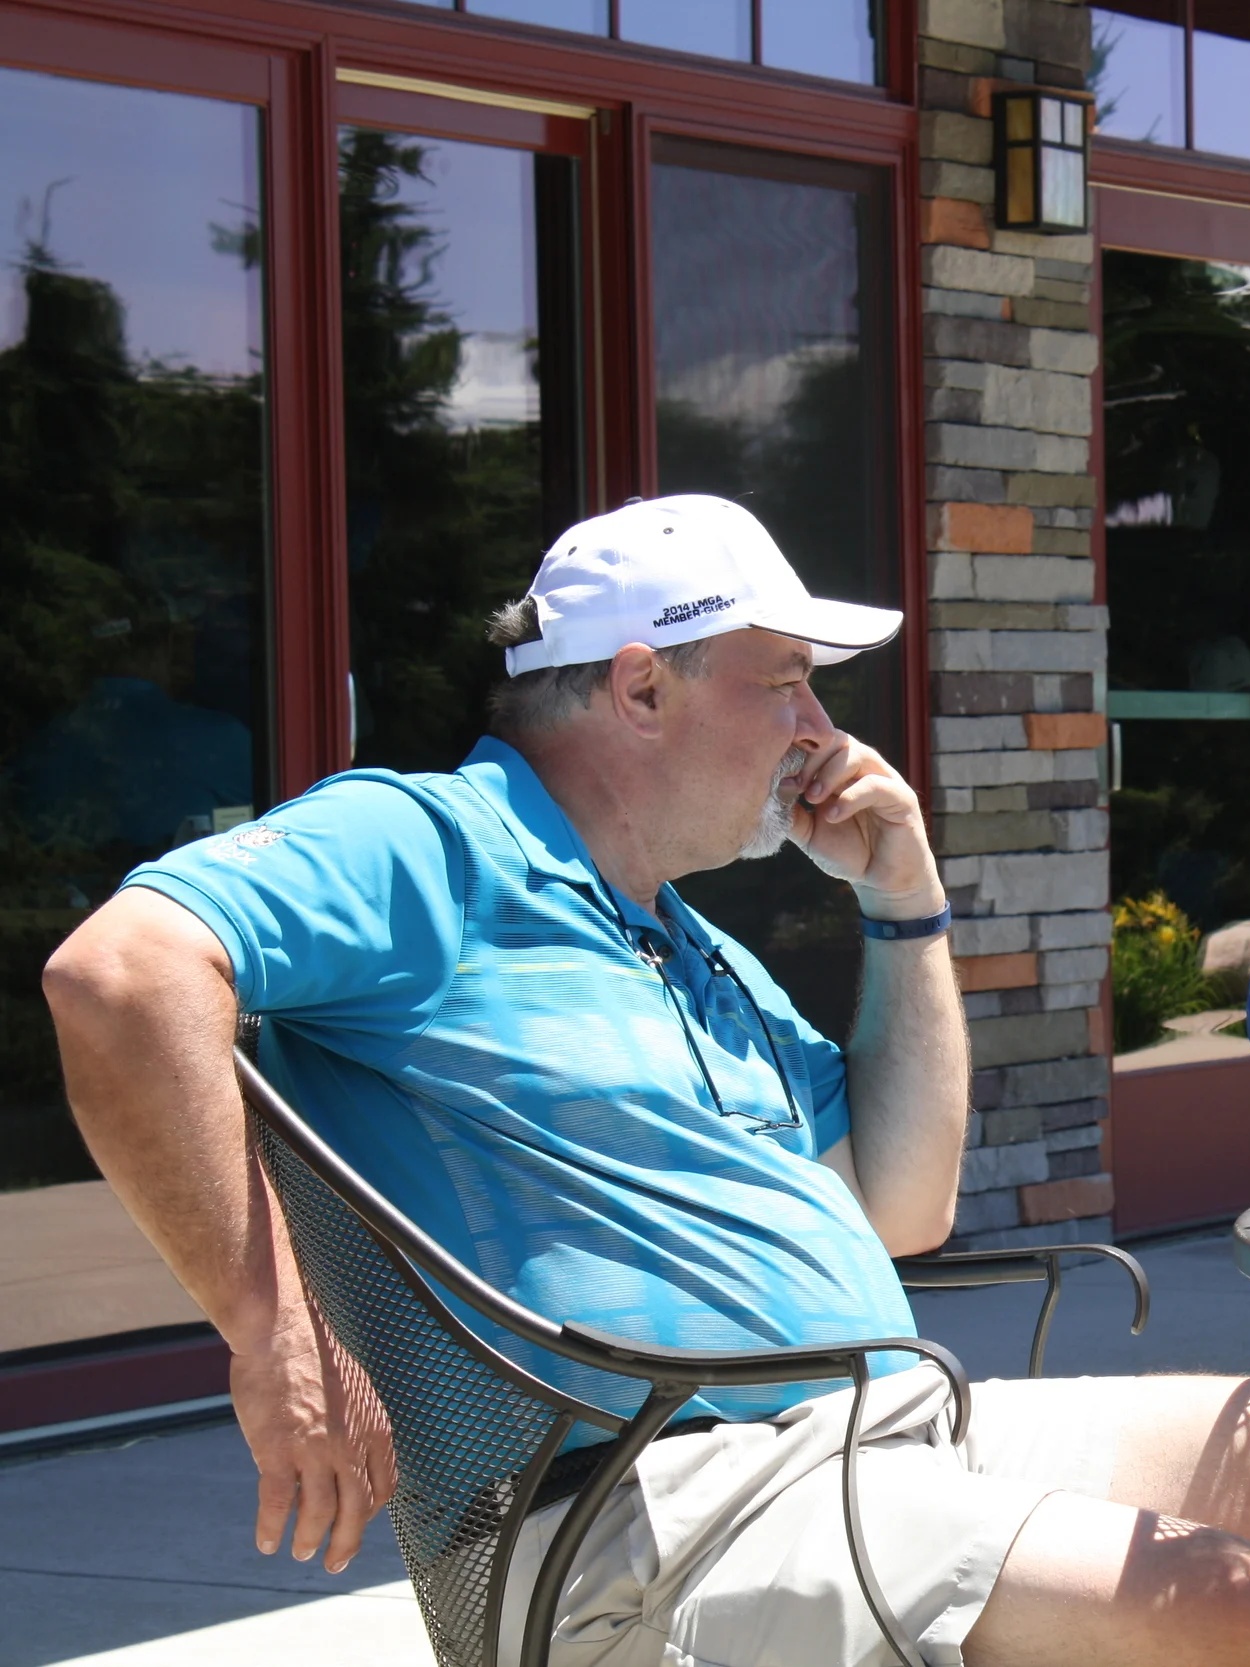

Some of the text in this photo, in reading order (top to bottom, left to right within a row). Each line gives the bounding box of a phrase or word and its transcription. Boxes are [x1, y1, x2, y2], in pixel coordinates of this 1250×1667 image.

[652, 597, 736, 628] MEMBER-GUEST
[662, 594, 723, 617] 2014 LMGA
